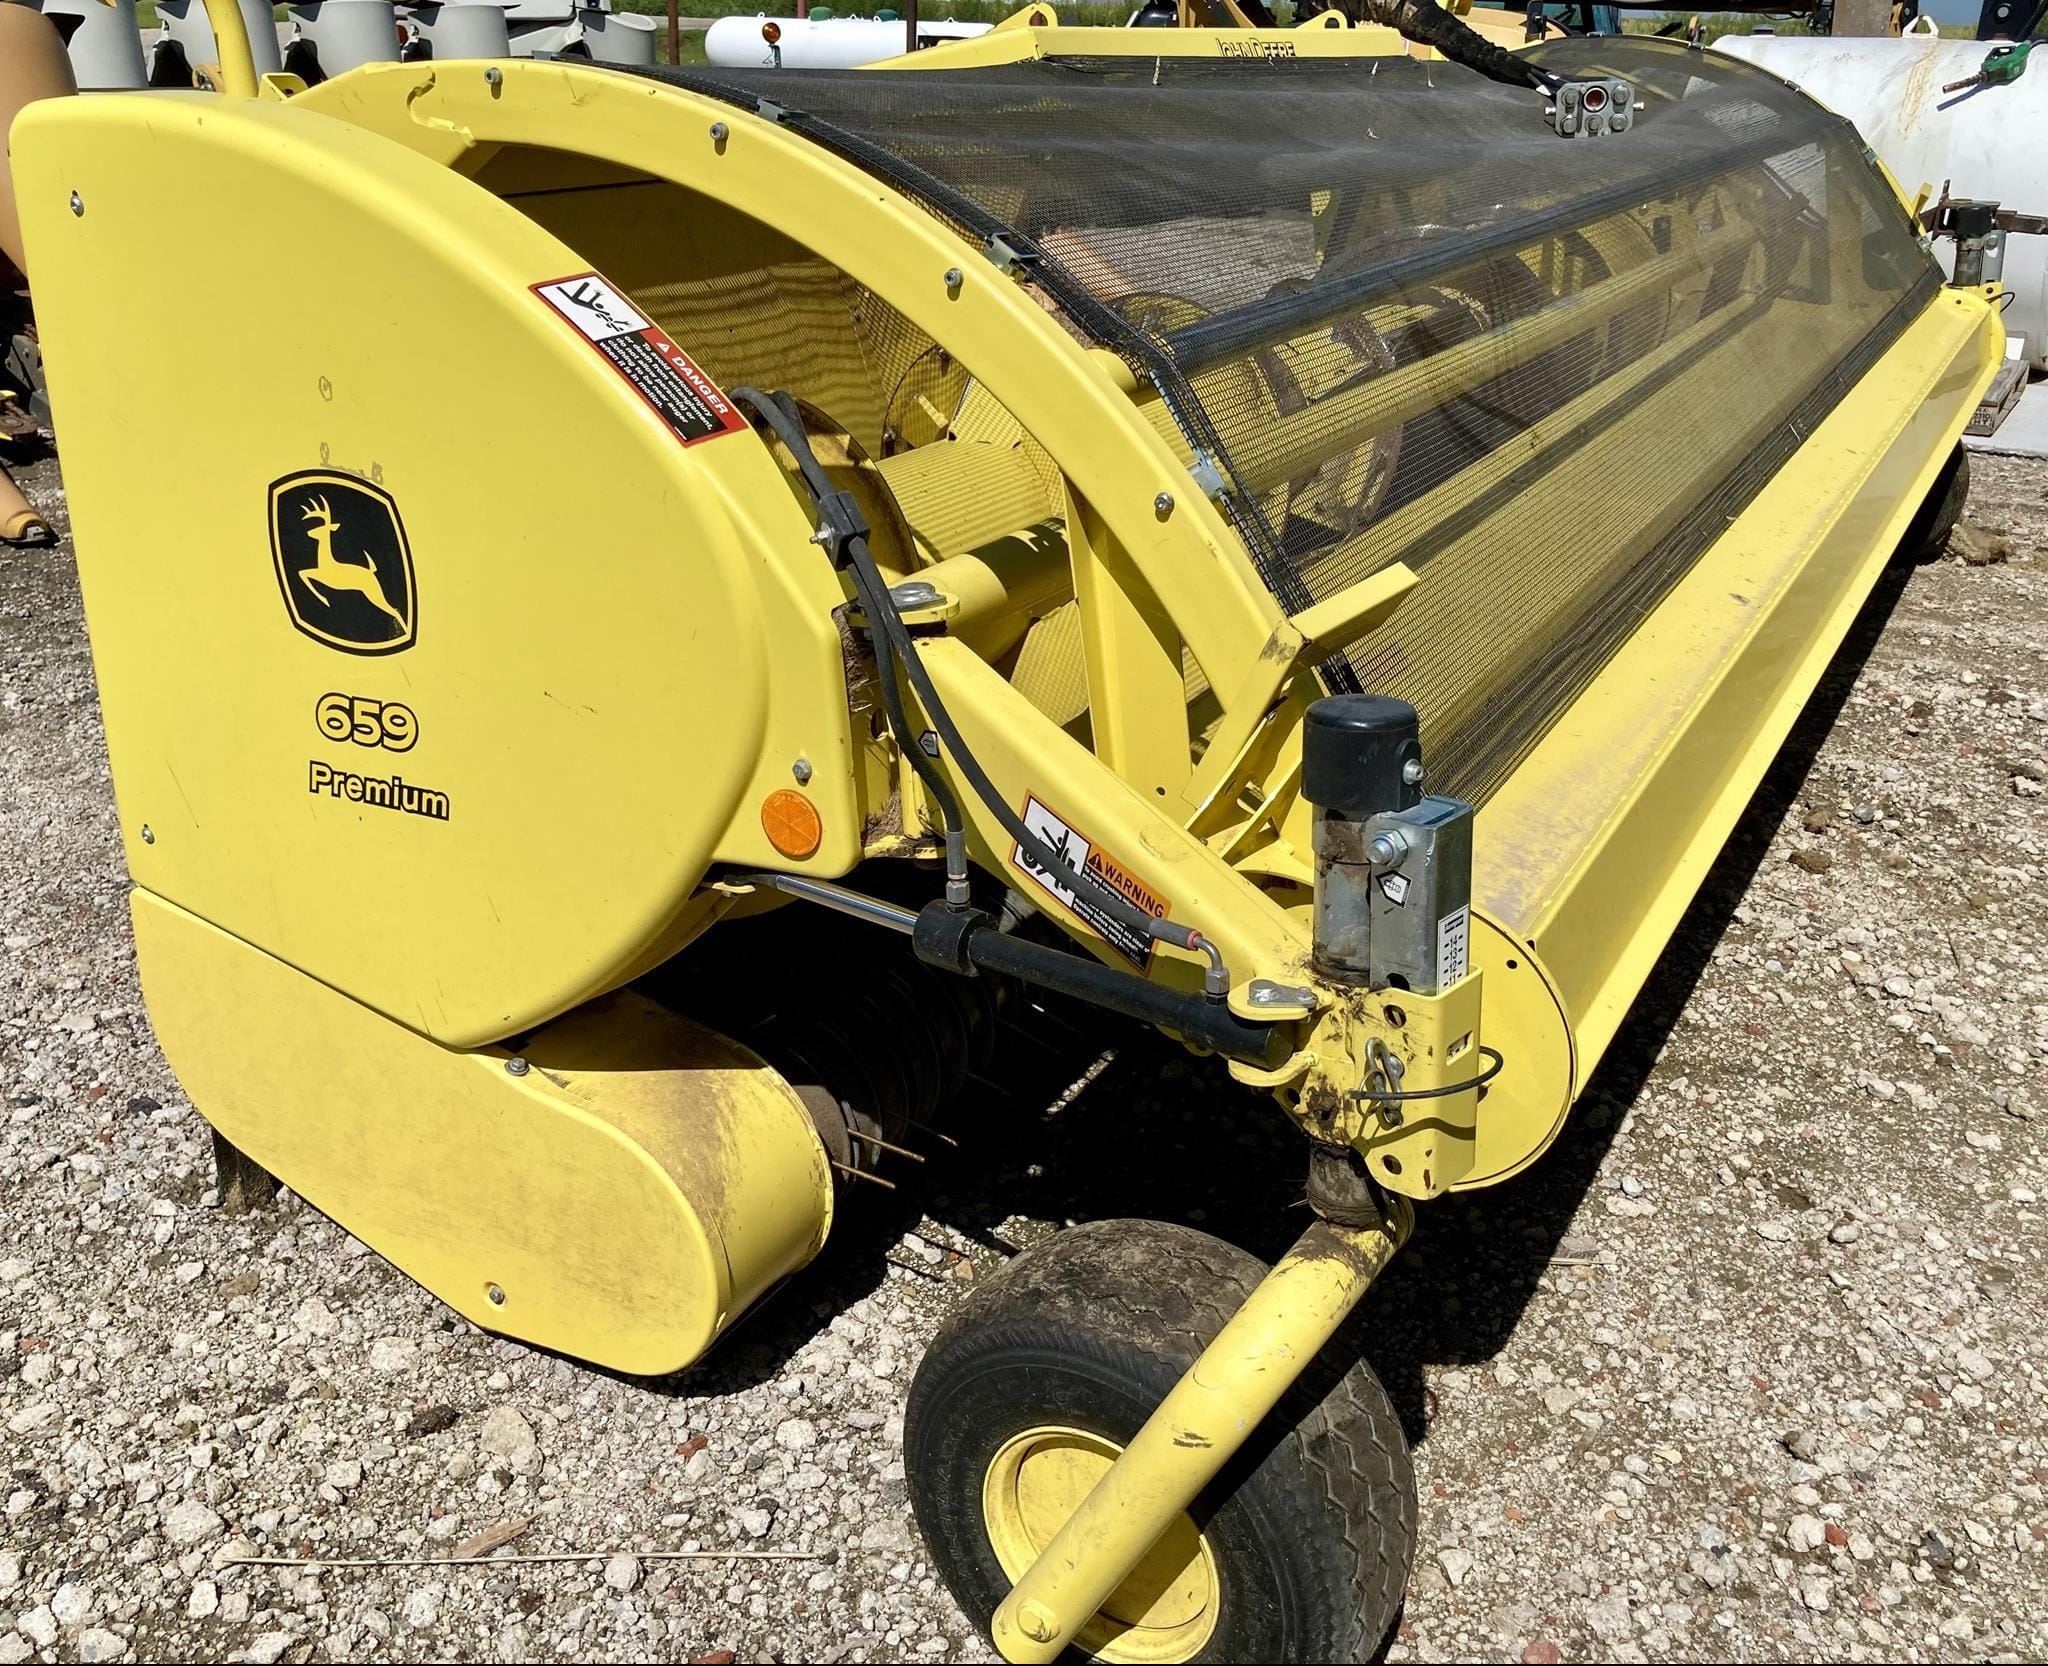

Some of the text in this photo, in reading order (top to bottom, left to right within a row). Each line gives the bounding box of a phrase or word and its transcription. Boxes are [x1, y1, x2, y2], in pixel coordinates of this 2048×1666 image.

[600, 342, 618, 360] when
[638, 382, 662, 408] motion.
[608, 340, 636, 366] clothing
[643, 376, 653, 384] be
[652, 386, 669, 401] near
[668, 403, 688, 423] auger
[616, 338, 626, 347] do
[626, 348, 639, 359] not
[638, 360, 657, 377] allow
[654, 379, 688, 410] person(s)
[633, 344, 652, 363] death
[652, 364, 668, 380] from
[668, 381, 712, 430] entanglement,
[642, 342, 712, 416] To avoid serious injury
[672, 356, 728, 415] DANGER
[315, 692, 419, 753] 659
[309, 760, 450, 821] Premium
[1083, 865, 1090, 874] To
[1106, 862, 1163, 918] WARNING
[1450, 935, 1458, 948] 14
[1450, 948, 1458, 960] 13
[1450, 960, 1457, 973] 12
